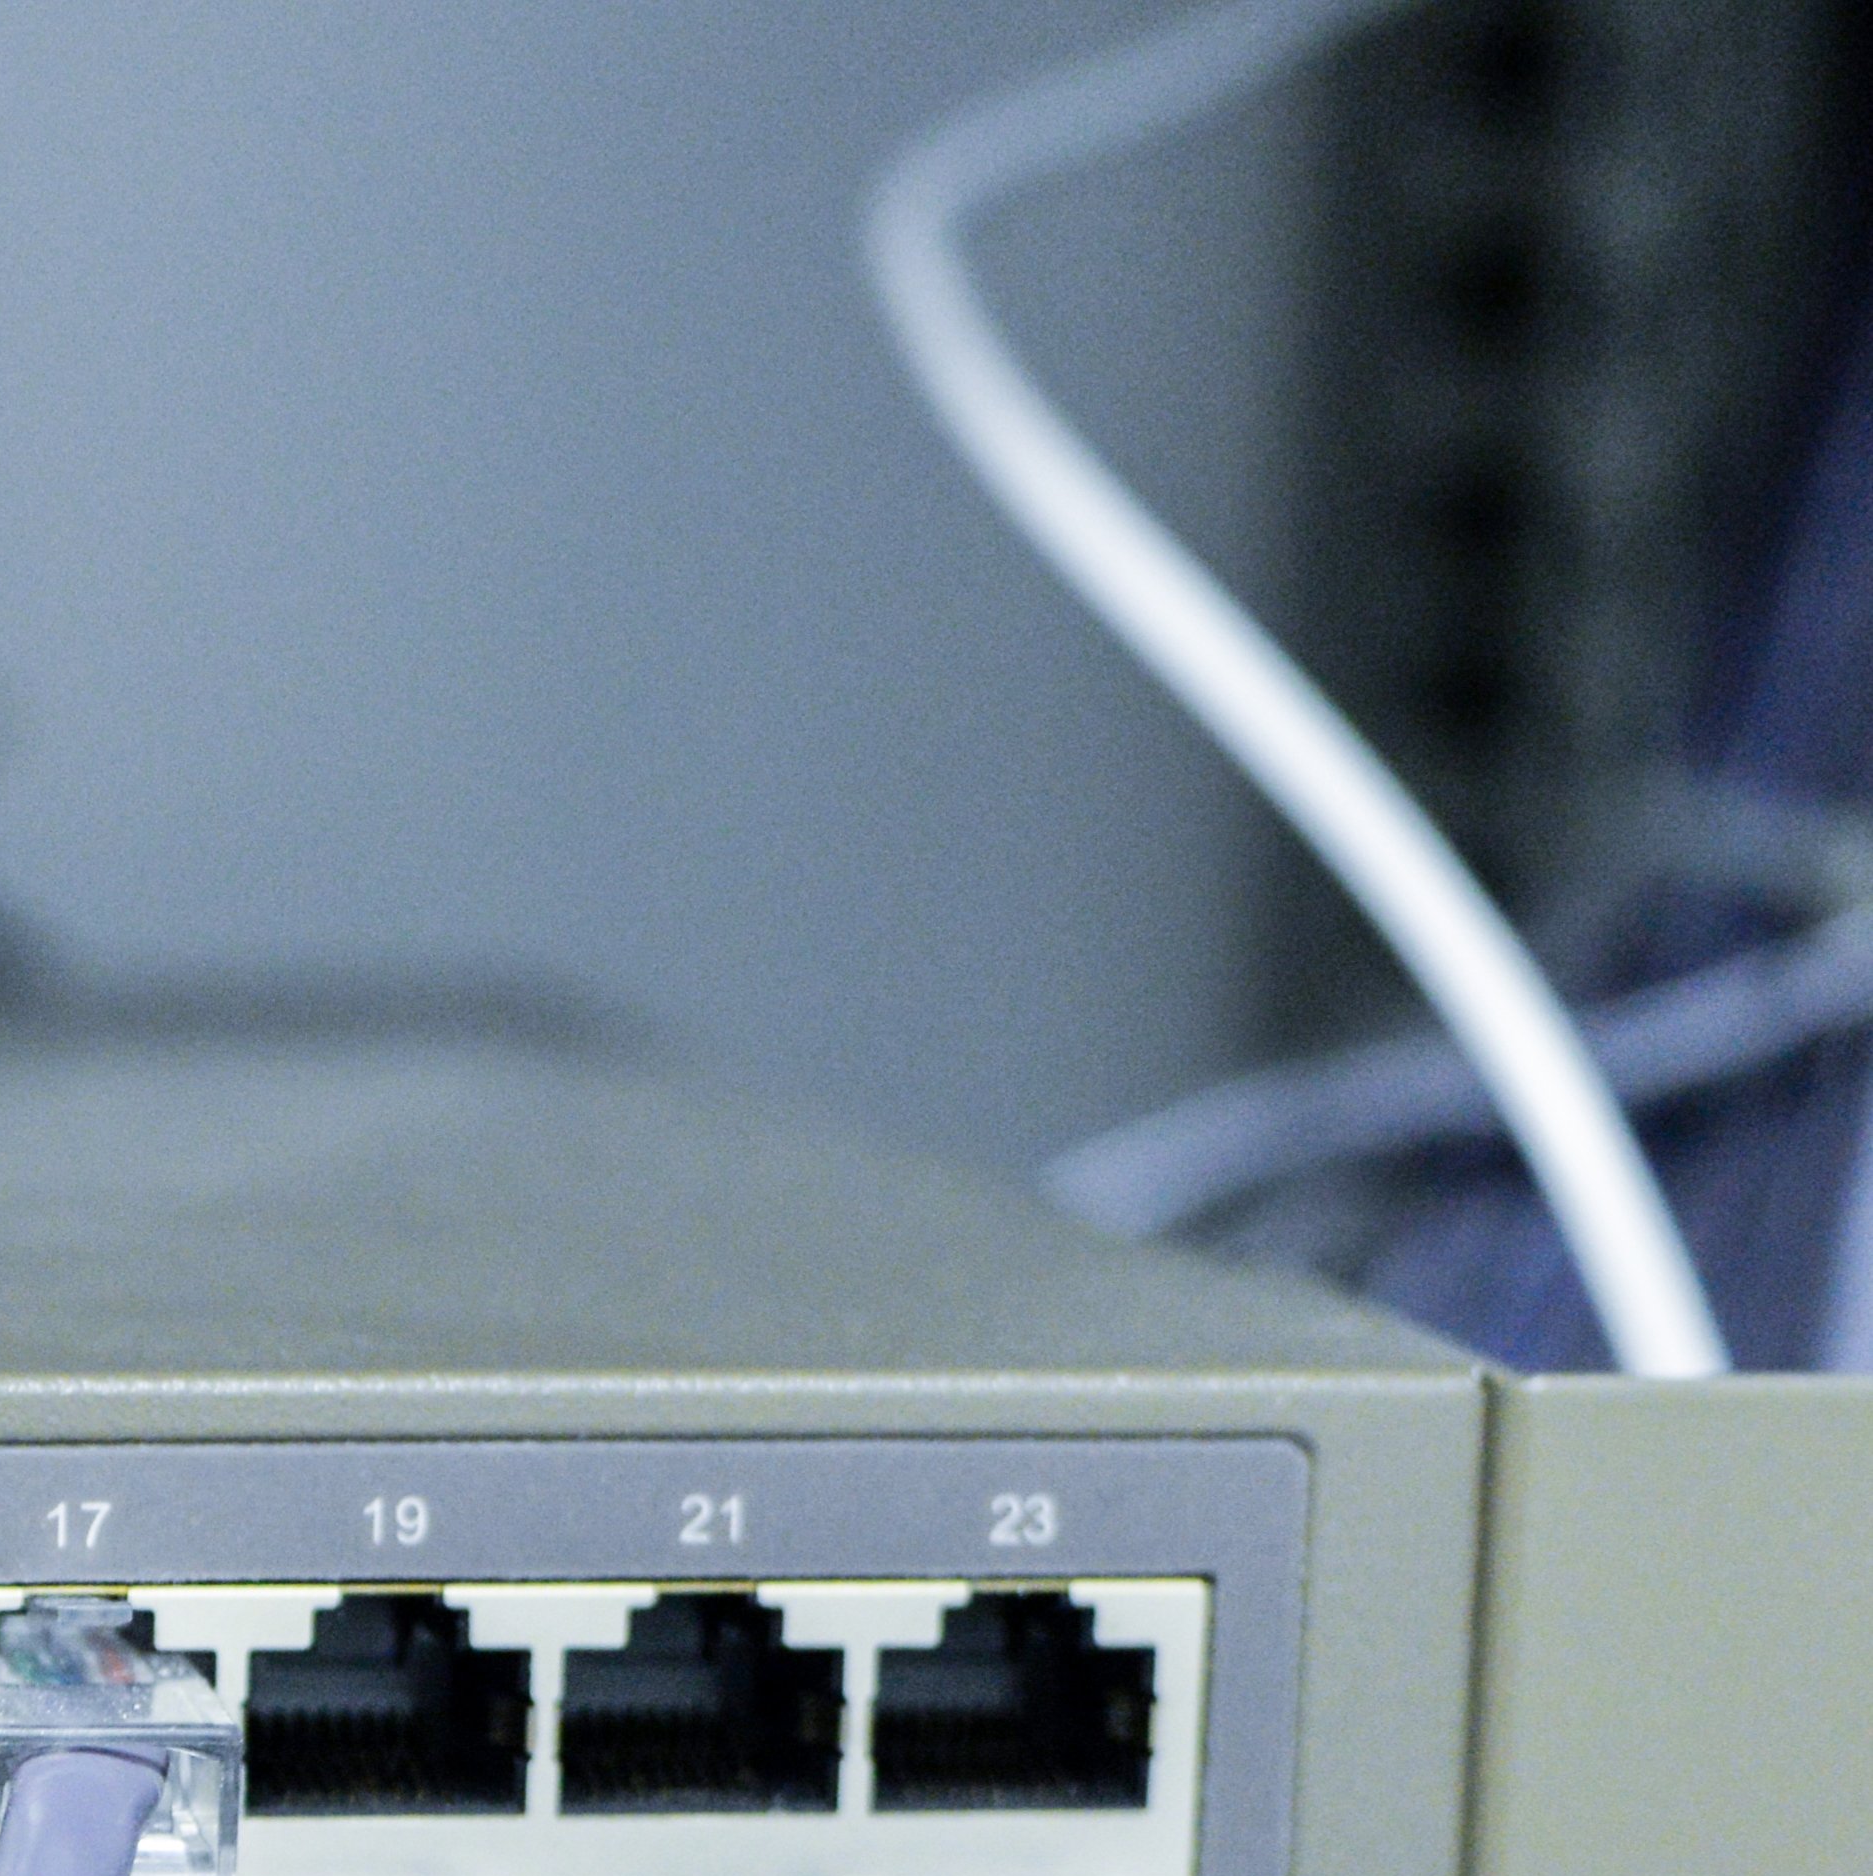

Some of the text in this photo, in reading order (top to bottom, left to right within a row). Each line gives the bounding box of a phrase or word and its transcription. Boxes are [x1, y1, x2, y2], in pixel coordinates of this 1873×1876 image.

[47, 1501, 112, 1549] 17
[364, 1496, 428, 1545] 19
[679, 1493, 743, 1544] 21
[990, 1494, 1055, 1544] 23
